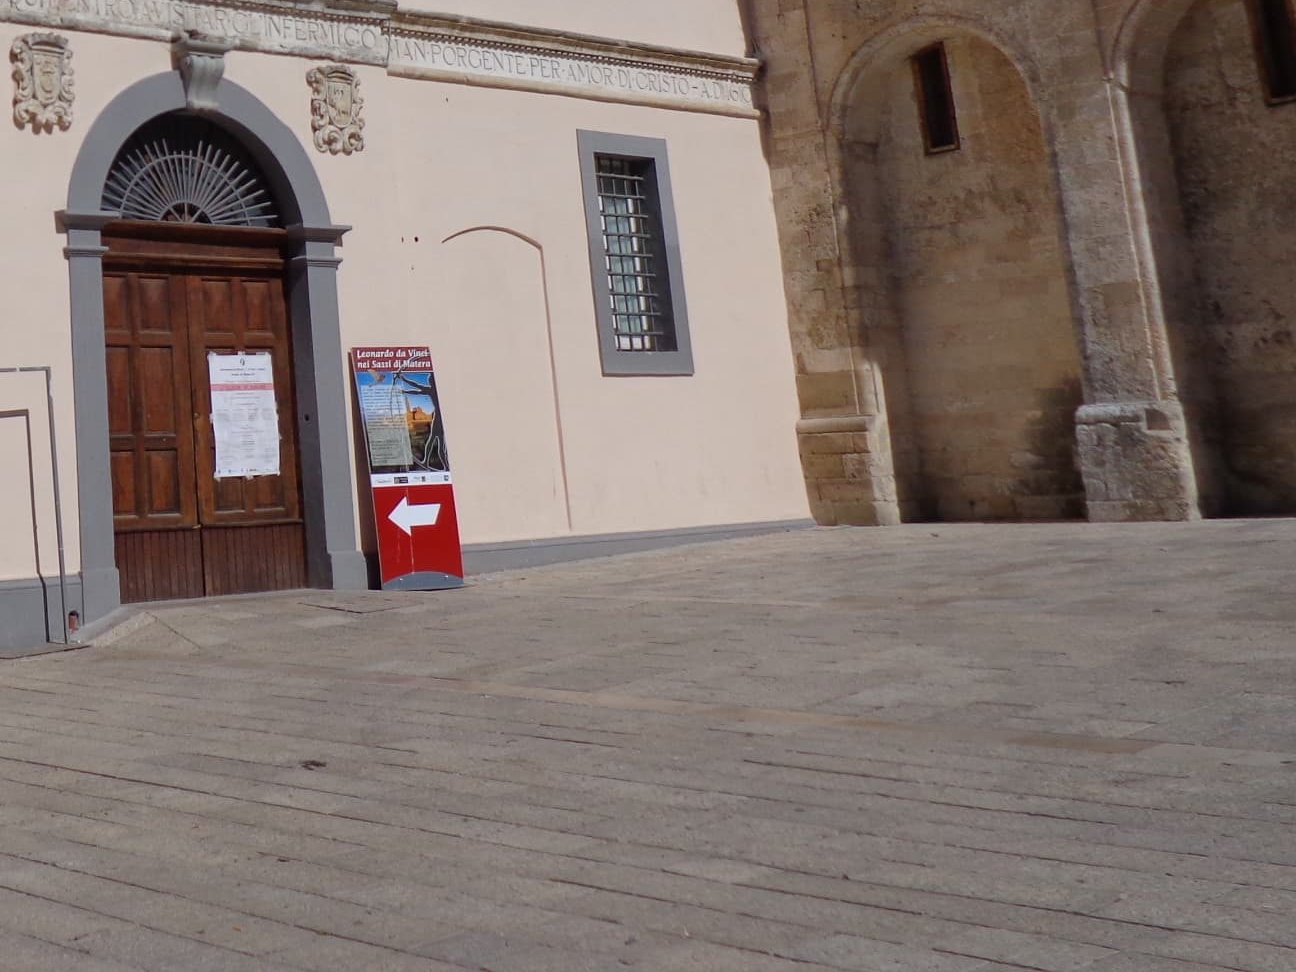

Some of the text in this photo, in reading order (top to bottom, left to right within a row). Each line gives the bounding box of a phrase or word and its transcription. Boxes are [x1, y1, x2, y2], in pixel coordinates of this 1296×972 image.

[430, 43, 526, 75] PORGENTE
[530, 56, 561, 79] PER
[567, 62, 613, 85] AMOR
[617, 67, 632, 89] DI
[635, 70, 690, 96] CRISTO
[356, 347, 428, 359] Leonardo da Vinci
[356, 358, 431, 369] nei Sassi di Matera
